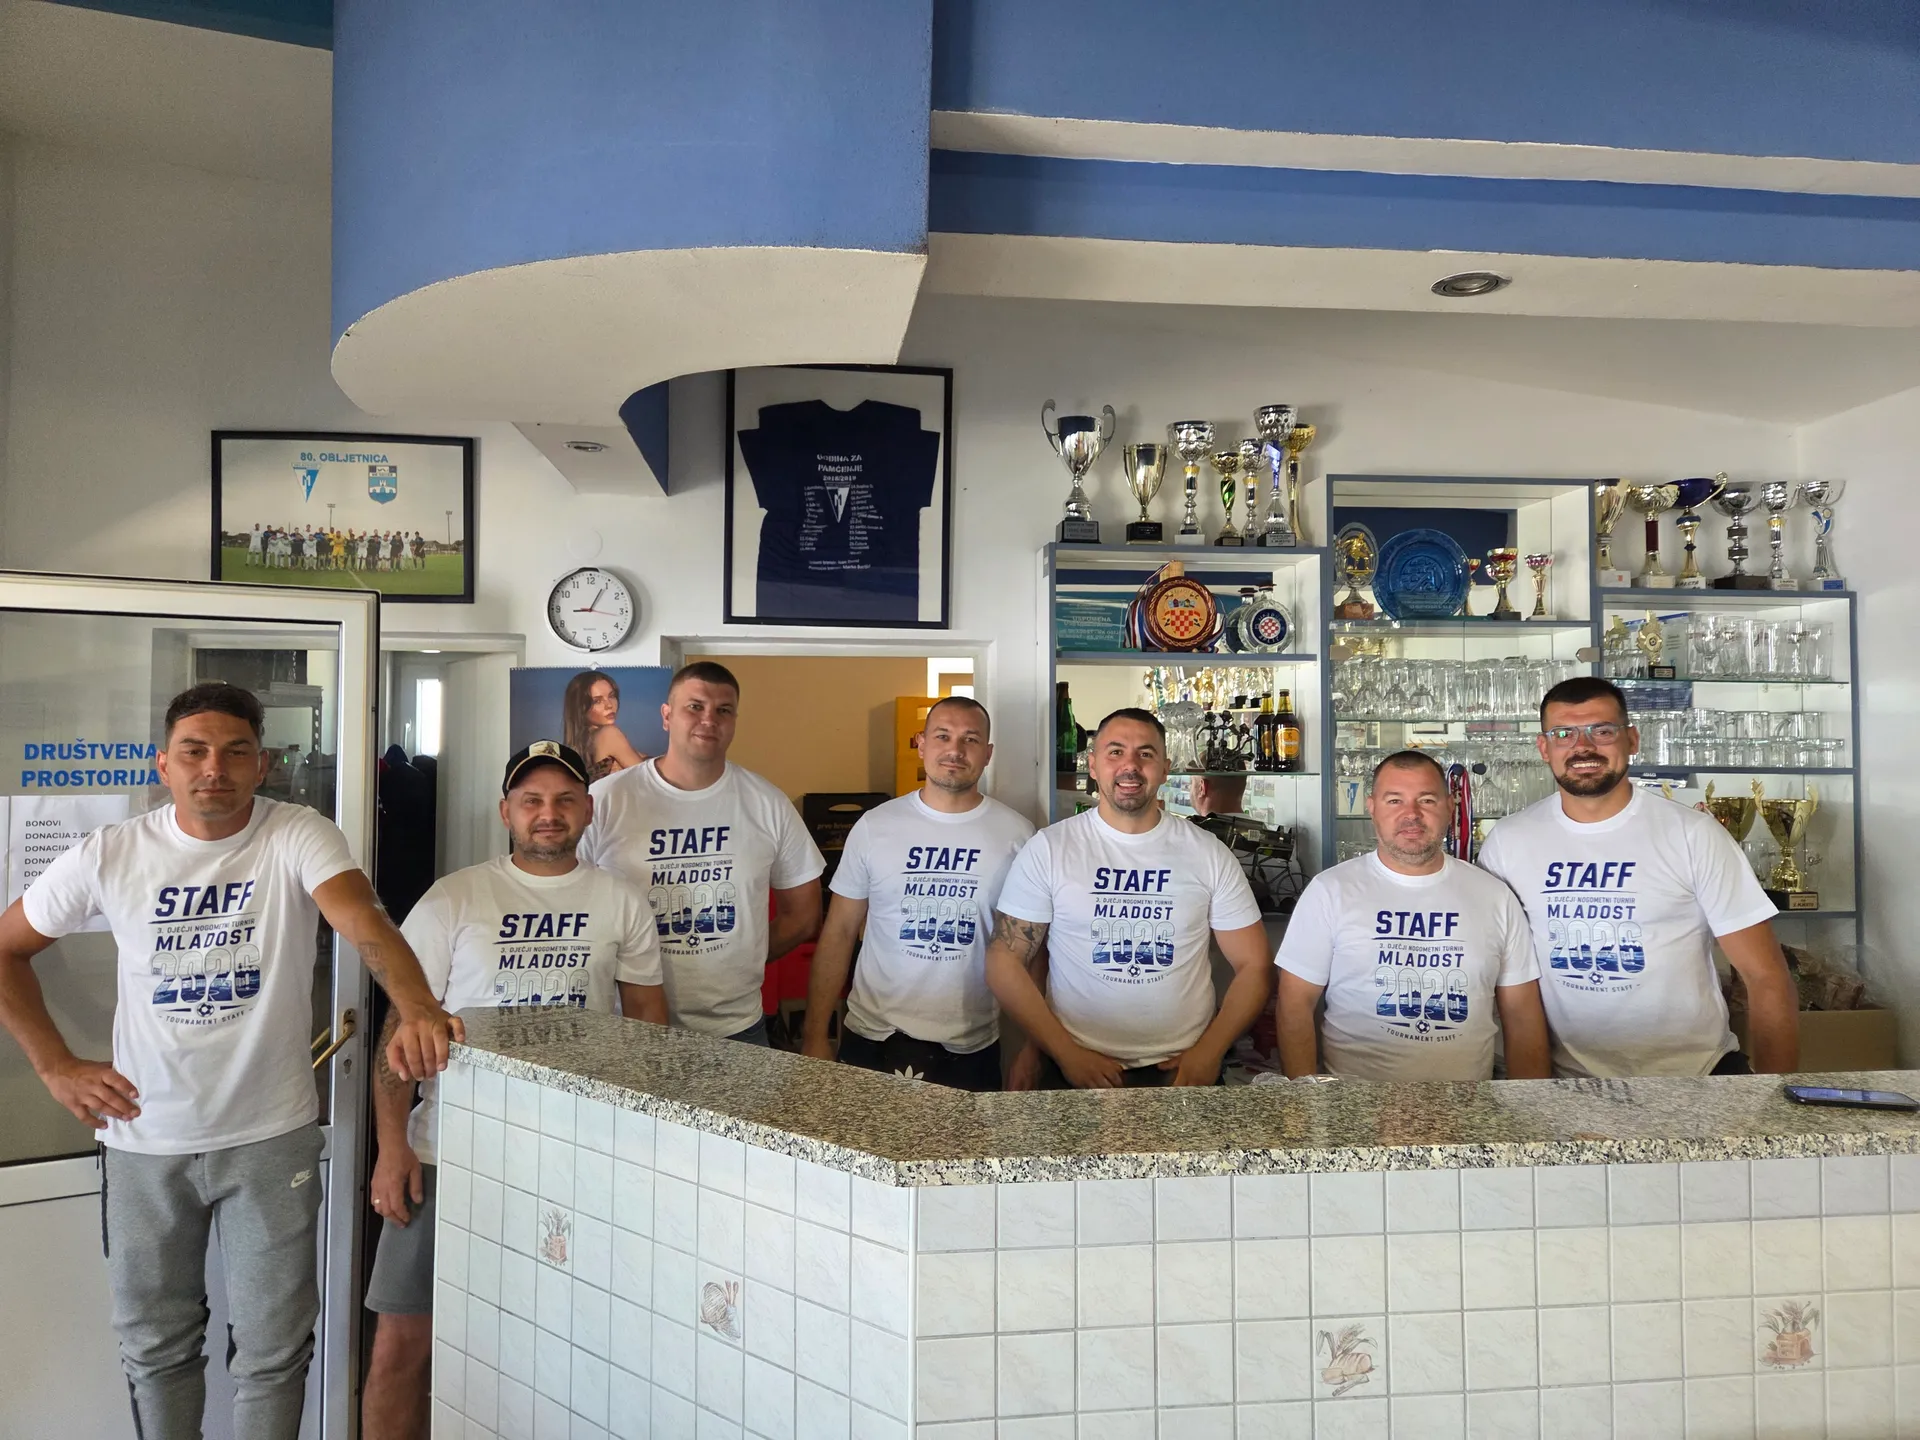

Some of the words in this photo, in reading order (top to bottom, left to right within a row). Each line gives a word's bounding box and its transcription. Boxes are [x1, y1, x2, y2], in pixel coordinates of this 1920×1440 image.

[300, 452, 316, 462] 80.
[319, 452, 389, 463] OBLJETNICA
[562, 590, 570, 598] 10
[24, 738, 158, 760] DRUŠTVENA
[21, 769, 160, 787] PROSTORIJA
[25, 832, 70, 840] DONACIJA
[649, 826, 730, 855] STAFF
[24, 844, 70, 852] DONACIJA
[906, 847, 981, 871] STAFF
[651, 867, 733, 886] MLADOST
[1094, 867, 1171, 892] STAFF
[1545, 862, 1636, 888] STAFF
[155, 880, 255, 917] STAFF
[904, 883, 978, 898] MLADOST
[648, 882, 736, 936] 2026
[1094, 904, 1173, 920] MLADOST
[1548, 904, 1636, 920] MLADOST
[167, 926, 192, 934] DJEČJI
[231, 918, 255, 928] TURNIR
[499, 913, 589, 938] STAFF
[899, 896, 978, 945] 2026
[1376, 910, 1459, 938] STAFF
[156, 926, 255, 951] MLADOST
[1091, 918, 1175, 967] 2026
[1548, 919, 1646, 973] 2026
[660, 947, 703, 955] TOURNAMENT
[706, 945, 724, 953] STAFF
[906, 950, 942, 961] TOURNAMENT
[1378, 950, 1464, 968] MLADOST
[499, 953, 591, 970] MLADOST
[152, 944, 260, 1005] 2026
[1102, 974, 1144, 985] TOURNAMENT
[1147, 975, 1164, 984] STAFF
[494, 969, 590, 1008] 2026
[1375, 966, 1468, 1023] 2026
[1562, 980, 1608, 992] TOURNAMENT
[1612, 984, 1632, 992] STAFF
[165, 1015, 218, 1025] TOURNAMENT
[222, 1011, 244, 1022] STAFF
[1387, 1028, 1433, 1042] TOURNAMENT
[1437, 1034, 1456, 1042] STAFF
